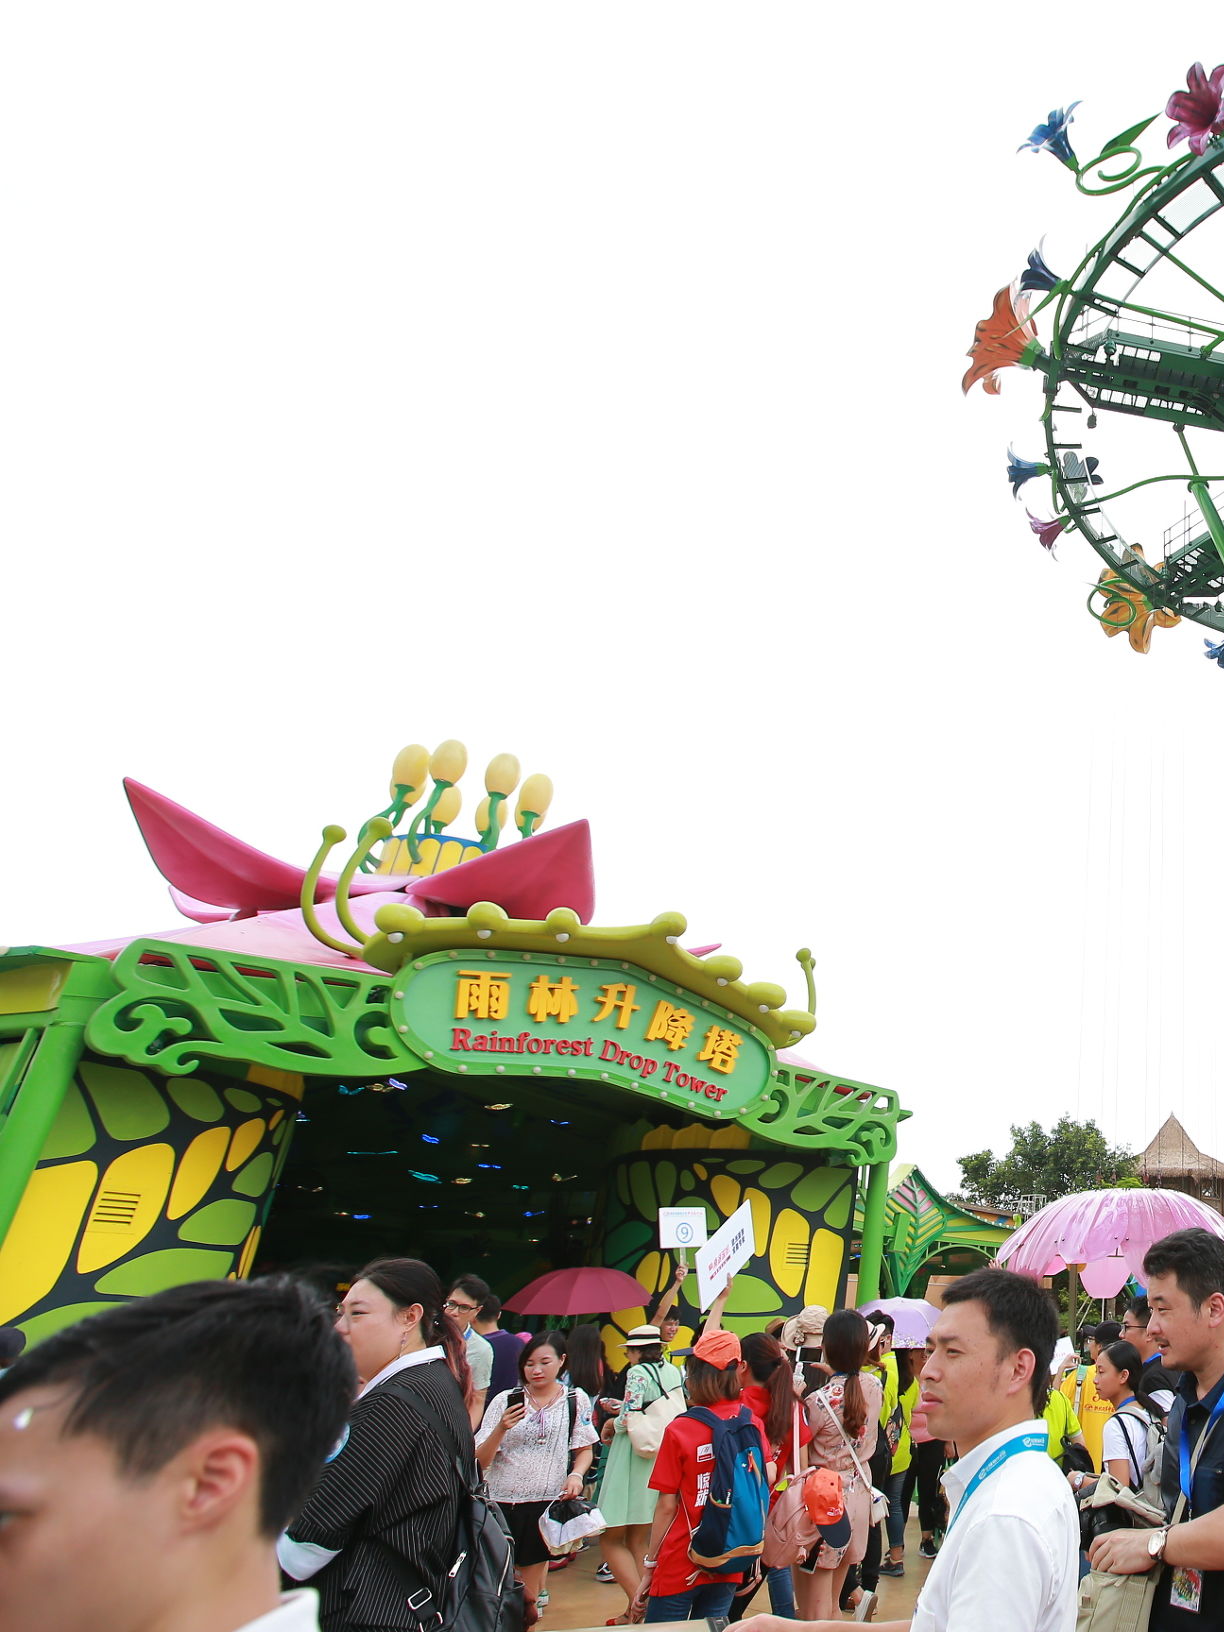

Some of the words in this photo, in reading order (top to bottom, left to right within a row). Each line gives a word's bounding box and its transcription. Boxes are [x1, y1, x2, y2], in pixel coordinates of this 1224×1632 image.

[450, 1027, 594, 1056] Rainforest
[599, 1039, 658, 1078] Drop
[662, 1060, 728, 1102] Tower
[454, 969, 744, 1075] 雨林升降塔
